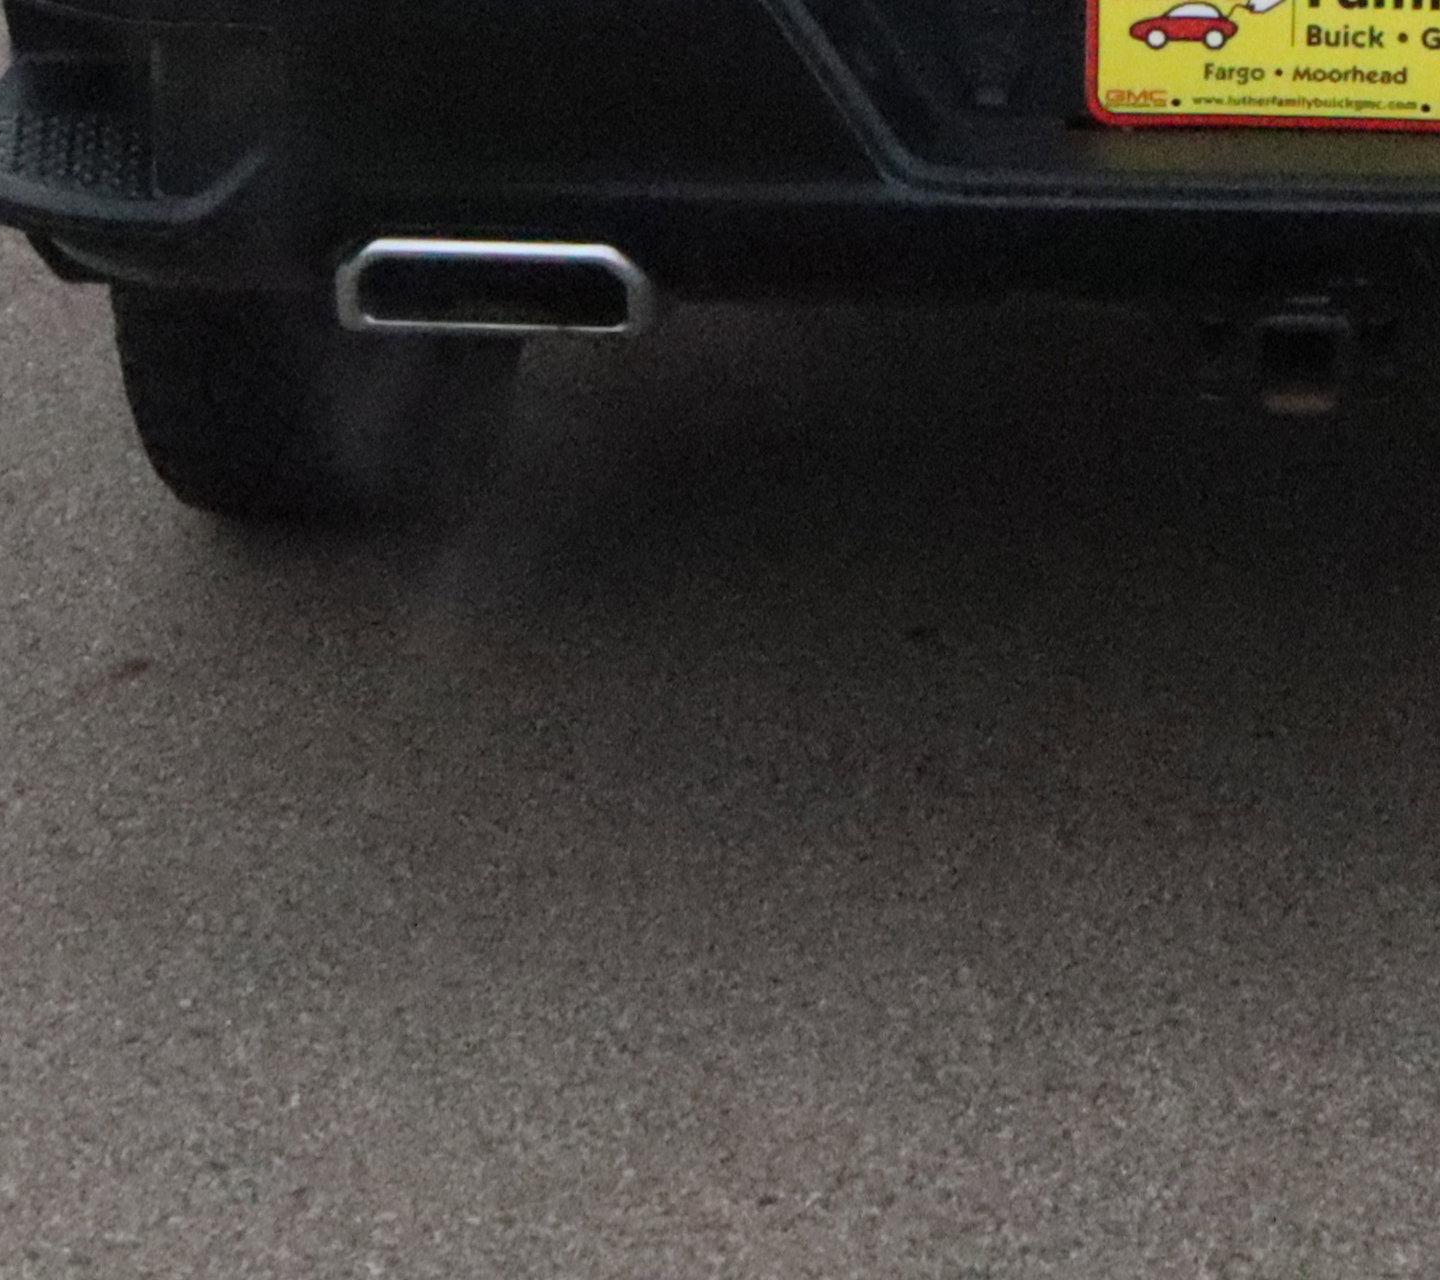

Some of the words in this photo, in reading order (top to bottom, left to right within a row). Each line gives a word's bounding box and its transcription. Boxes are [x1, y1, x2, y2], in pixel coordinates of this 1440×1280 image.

[1306, 24, 1384, 48] Buick
[1203, 62, 1265, 85] Fargo
[1292, 65, 1408, 85] Moorhead
[1105, 89, 1168, 105] GMC
